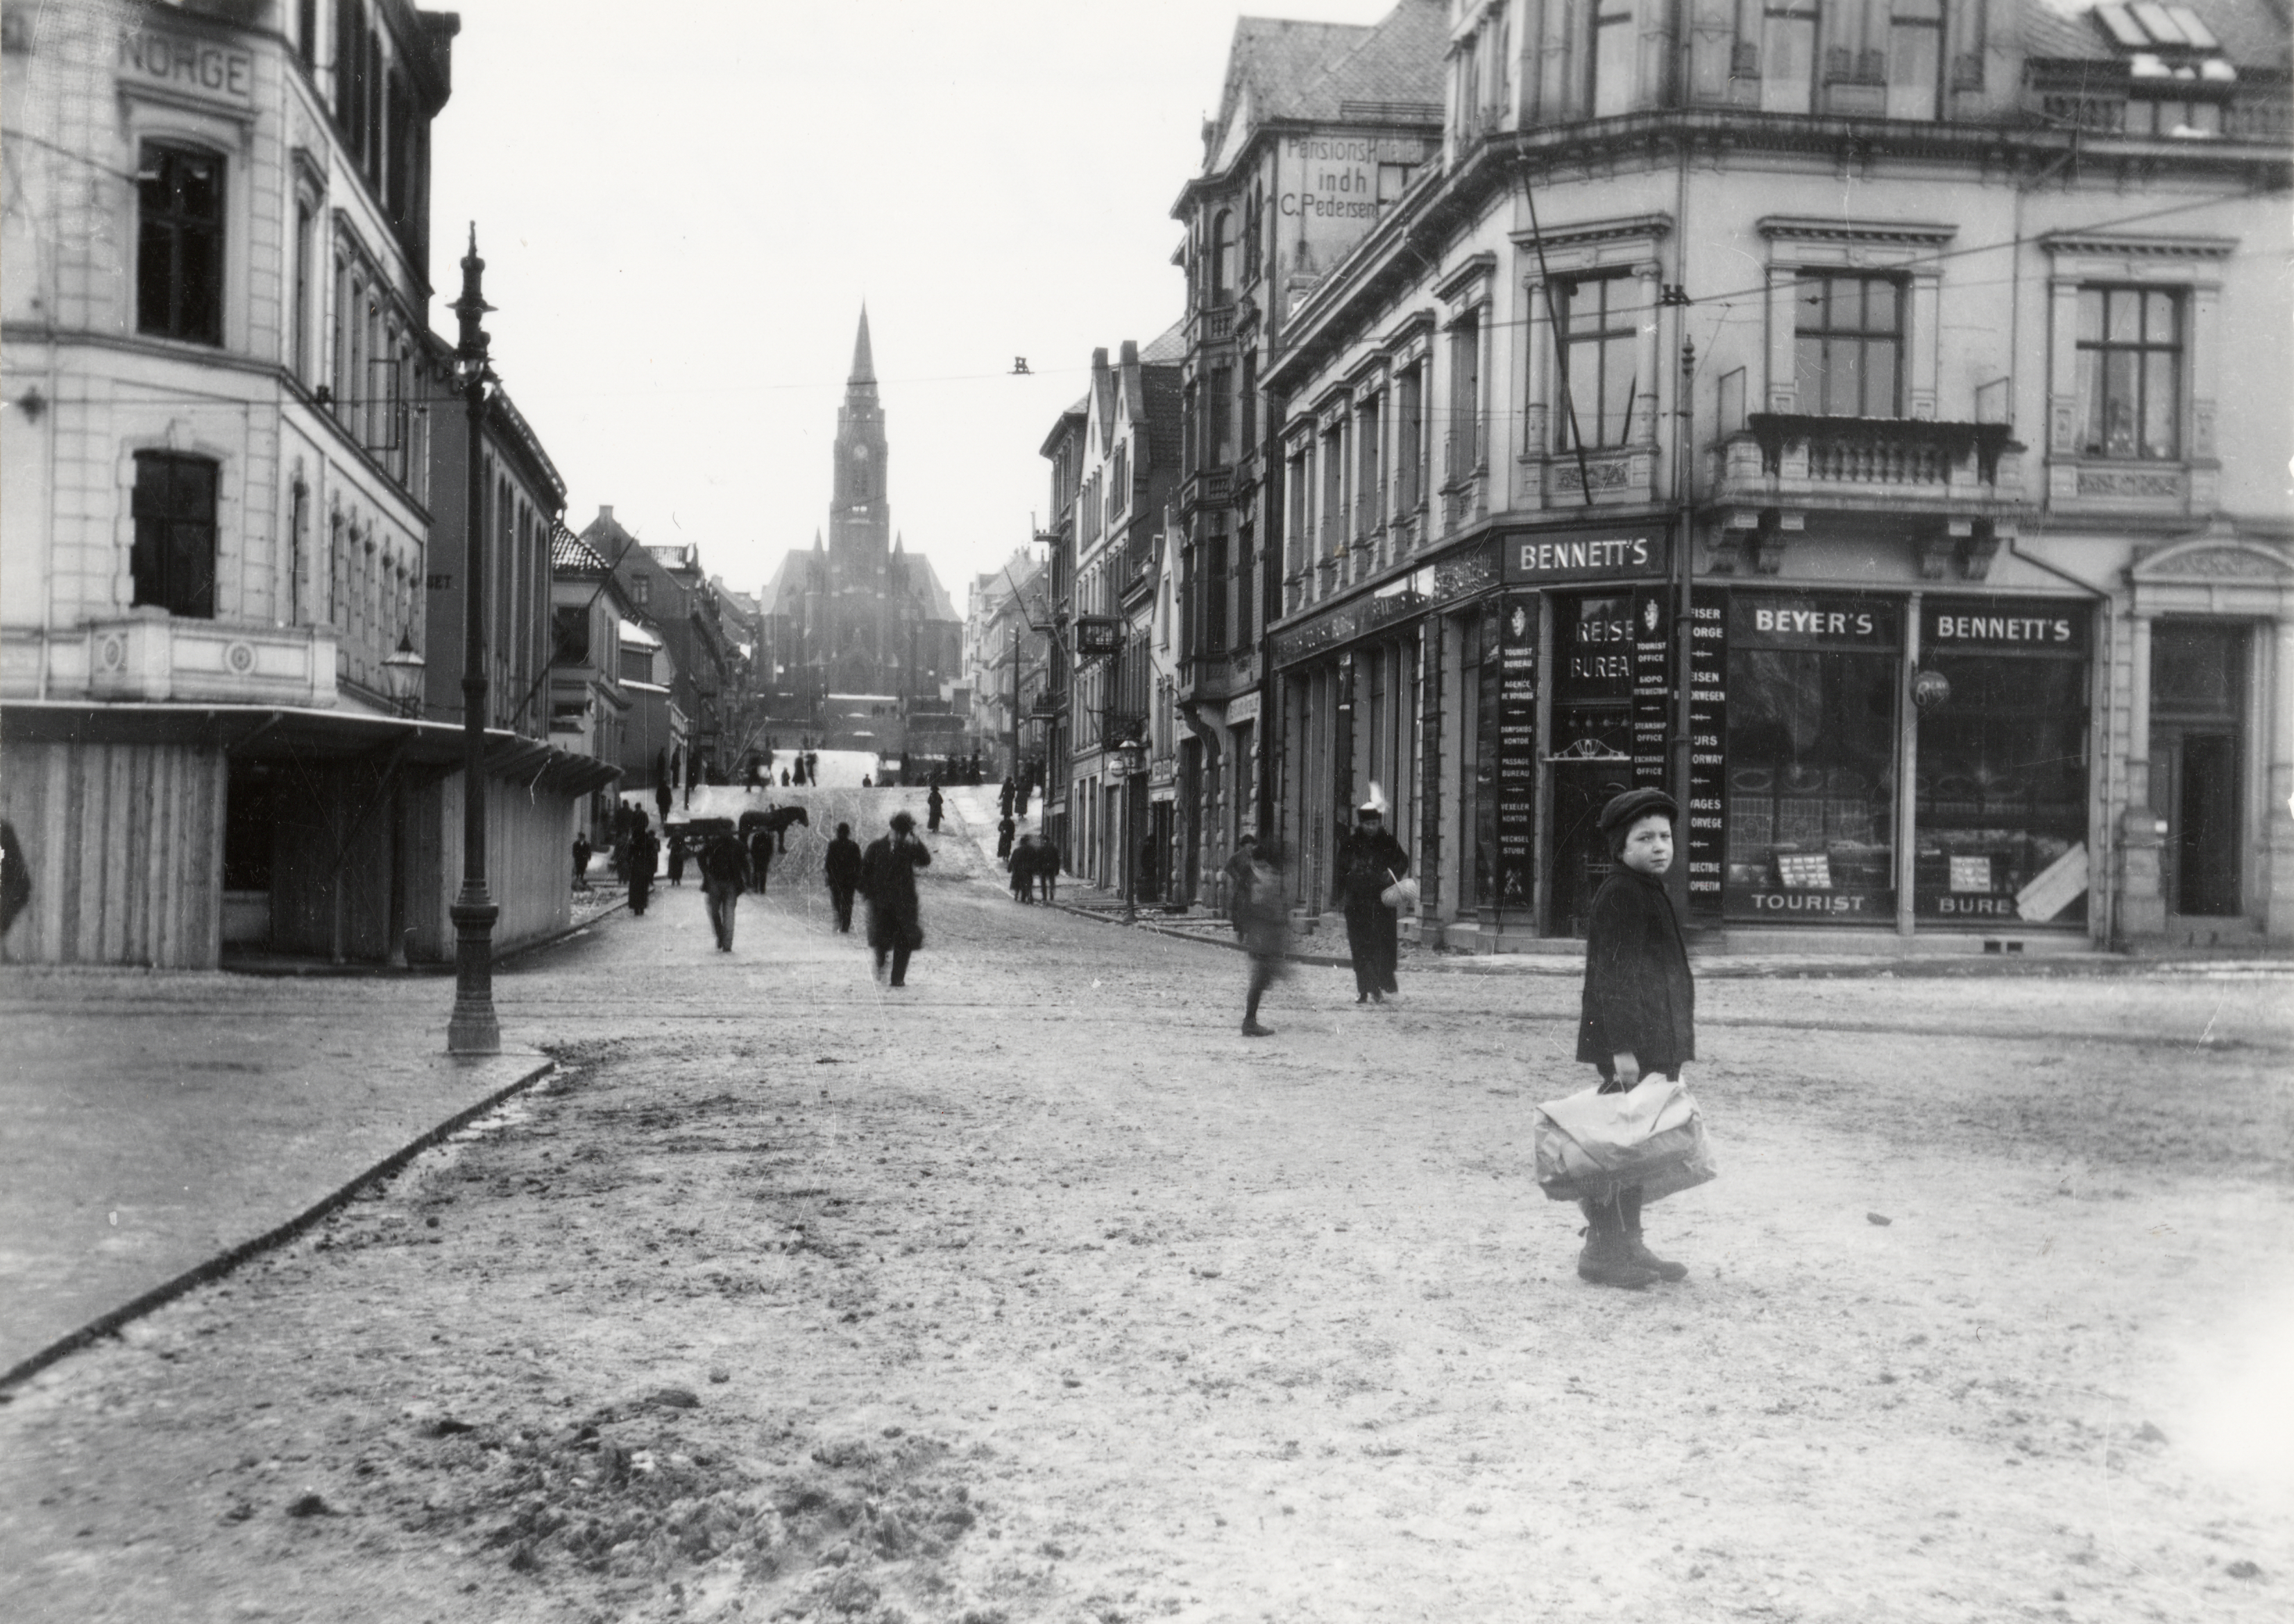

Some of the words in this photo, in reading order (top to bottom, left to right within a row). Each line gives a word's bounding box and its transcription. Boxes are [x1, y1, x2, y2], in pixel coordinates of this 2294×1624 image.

[119, 28, 248, 96] NORGE
[1520, 538, 1648, 570] BENNETT'S
[1690, 608, 1721, 619] ISER
[1756, 610, 1873, 635] BEYER'S
[1576, 619, 1633, 642] REISE
[1692, 626, 1724, 638] ORGE
[1938, 616, 2071, 641] BENNETT'S
[1504, 648, 1533, 656] TOURIST
[1637, 642, 1667, 651] TOURIST
[1638, 654, 1665, 663] OFFICE
[1570, 656, 1630, 678] BUREA
[1690, 672, 1719, 683] ISEN
[1636, 734, 1663, 742] OFFICE
[1694, 735, 1718, 746] URS
[1692, 753, 1724, 764] ORWAY
[1636, 767, 1663, 776] OFFICE
[1691, 817, 1722, 828] ORVEGE
[1751, 895, 1865, 910] TOURIST
[1939, 898, 2012, 913] BURE
